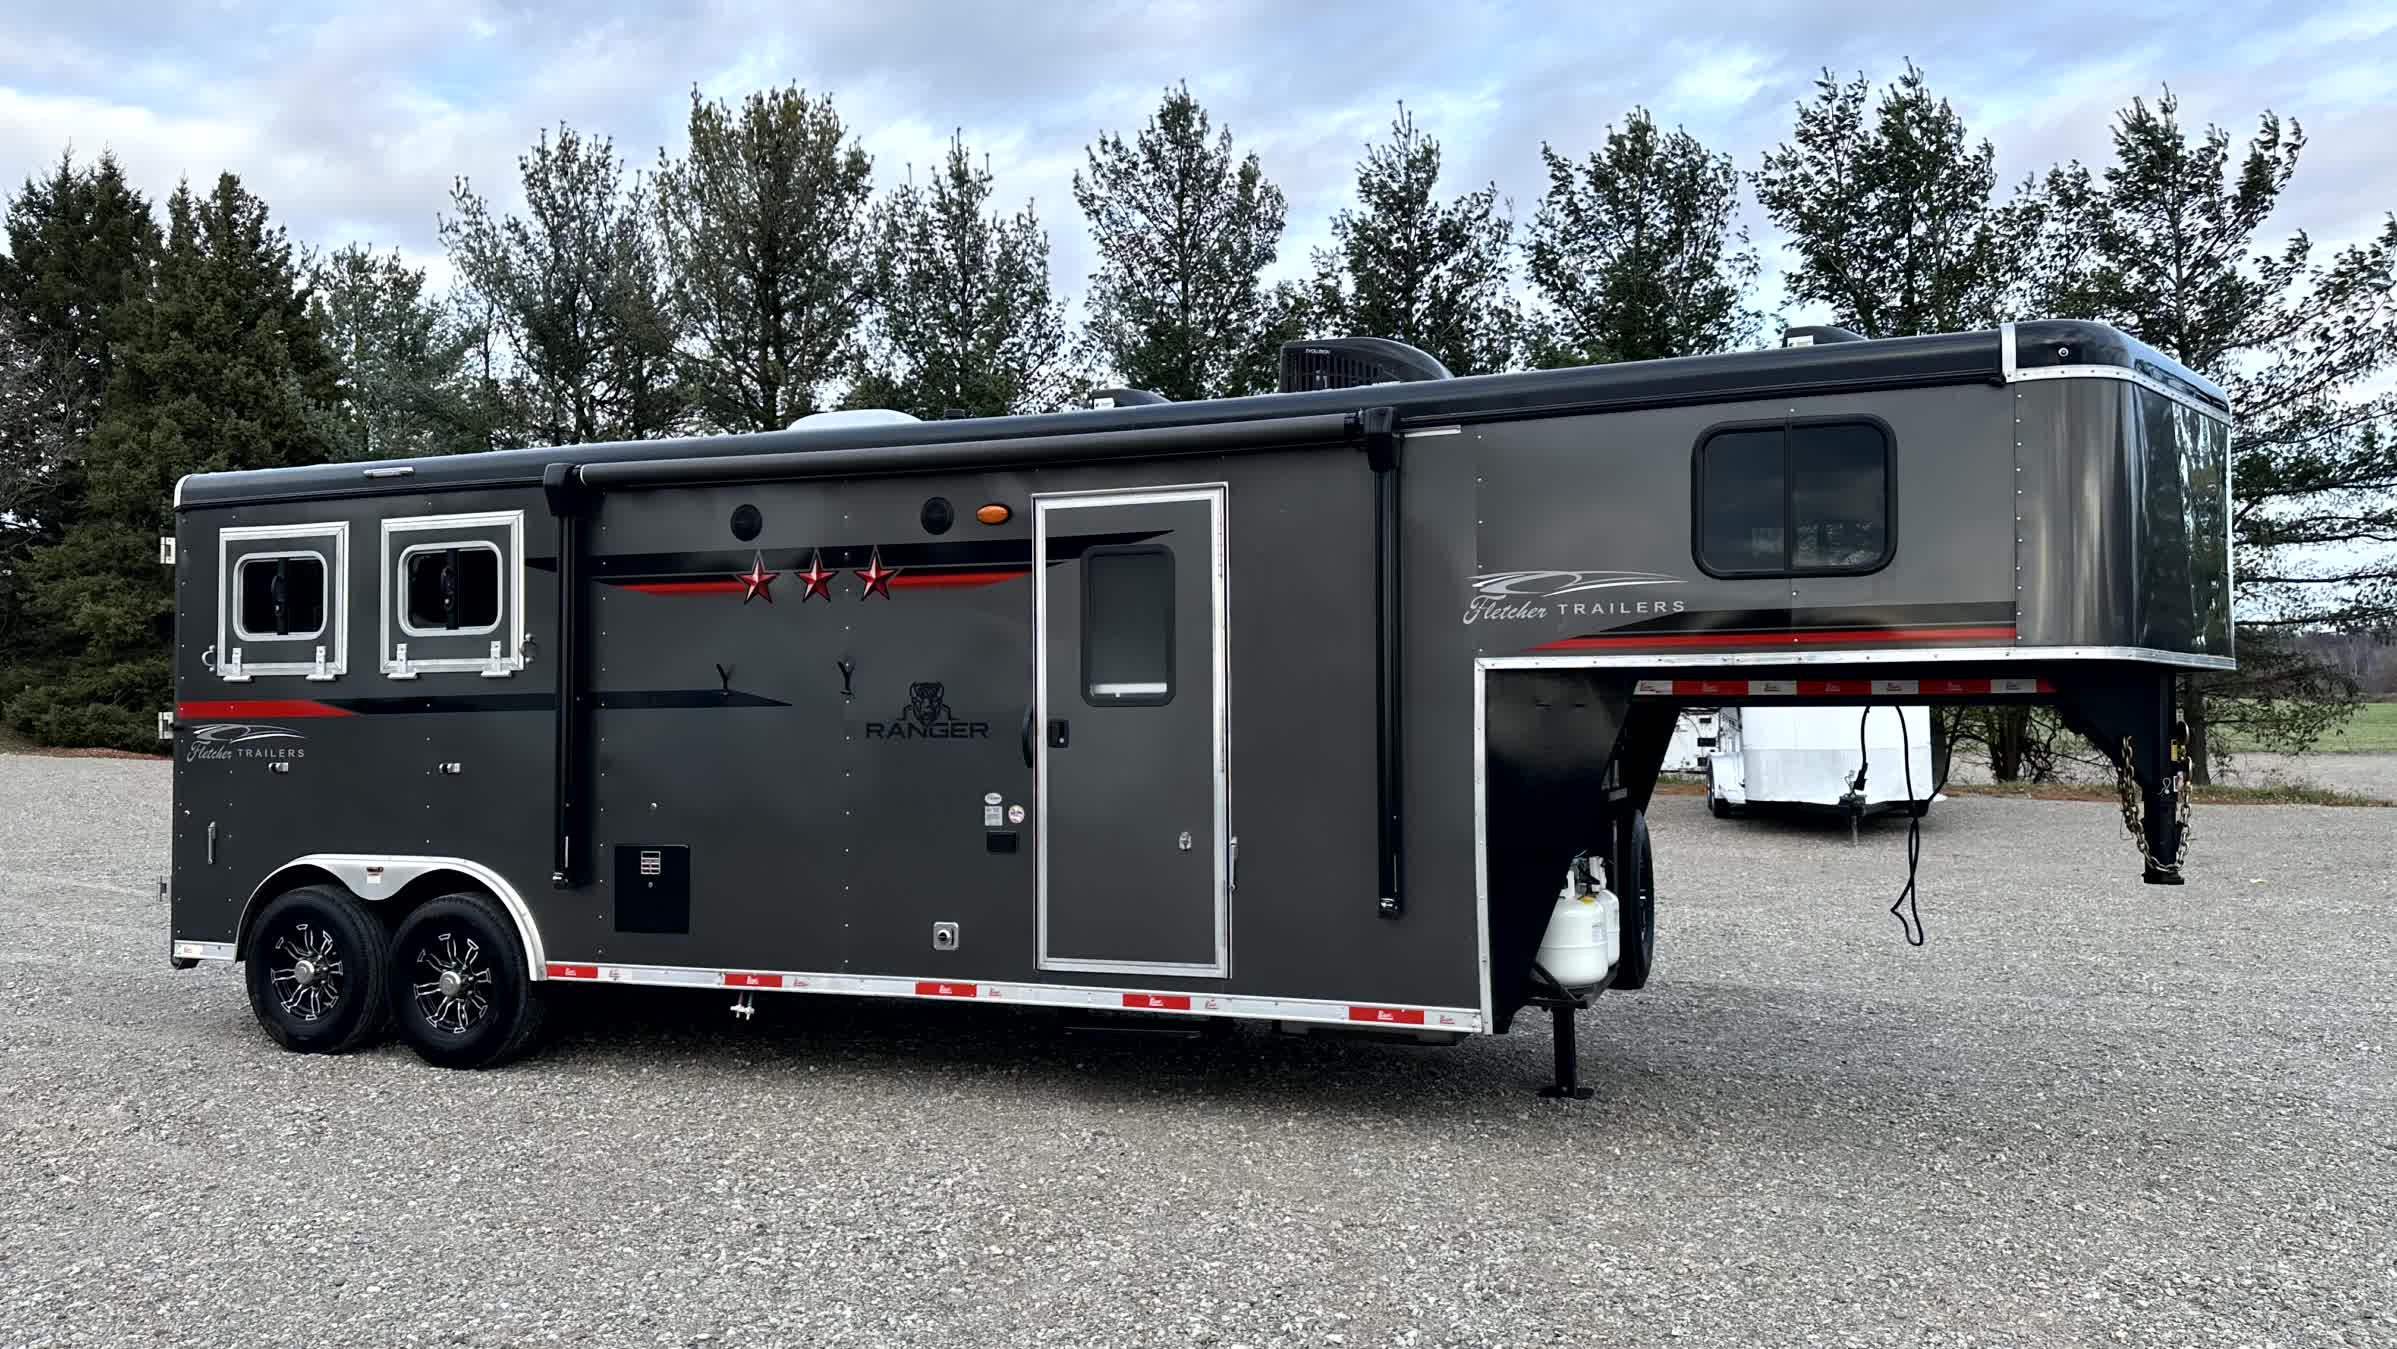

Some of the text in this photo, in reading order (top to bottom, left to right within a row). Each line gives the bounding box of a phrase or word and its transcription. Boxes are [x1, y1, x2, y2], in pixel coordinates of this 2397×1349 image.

[1463, 594, 1685, 625] Fletcher TRAILERS
[866, 722, 990, 739] RANGER
[187, 740, 305, 762] Fletcher TRAILERS
